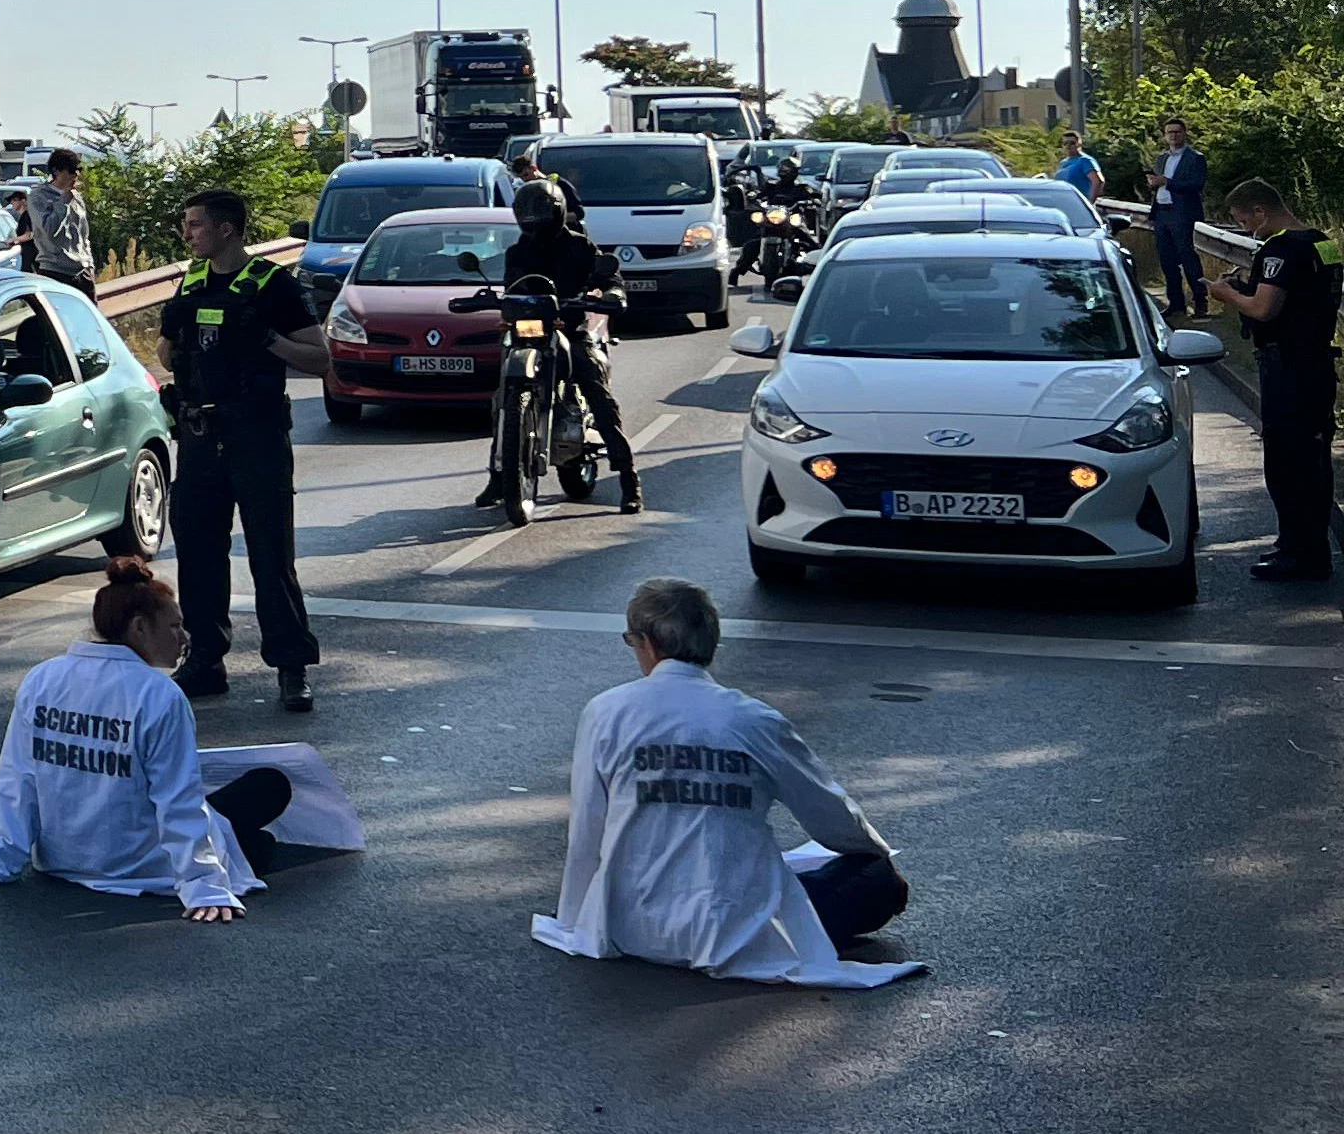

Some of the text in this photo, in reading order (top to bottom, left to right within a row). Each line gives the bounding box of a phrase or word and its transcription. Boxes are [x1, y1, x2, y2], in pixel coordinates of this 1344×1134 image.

[419, 358, 437, 370] HS
[439, 358, 472, 371] 8898
[895, 493, 1021, 517] B AP 2232
[33, 705, 132, 743] SCIENTIST
[32, 736, 132, 778] REBELLION
[633, 744, 752, 776] SCIENTIST
[635, 778, 753, 809] REBELLION
